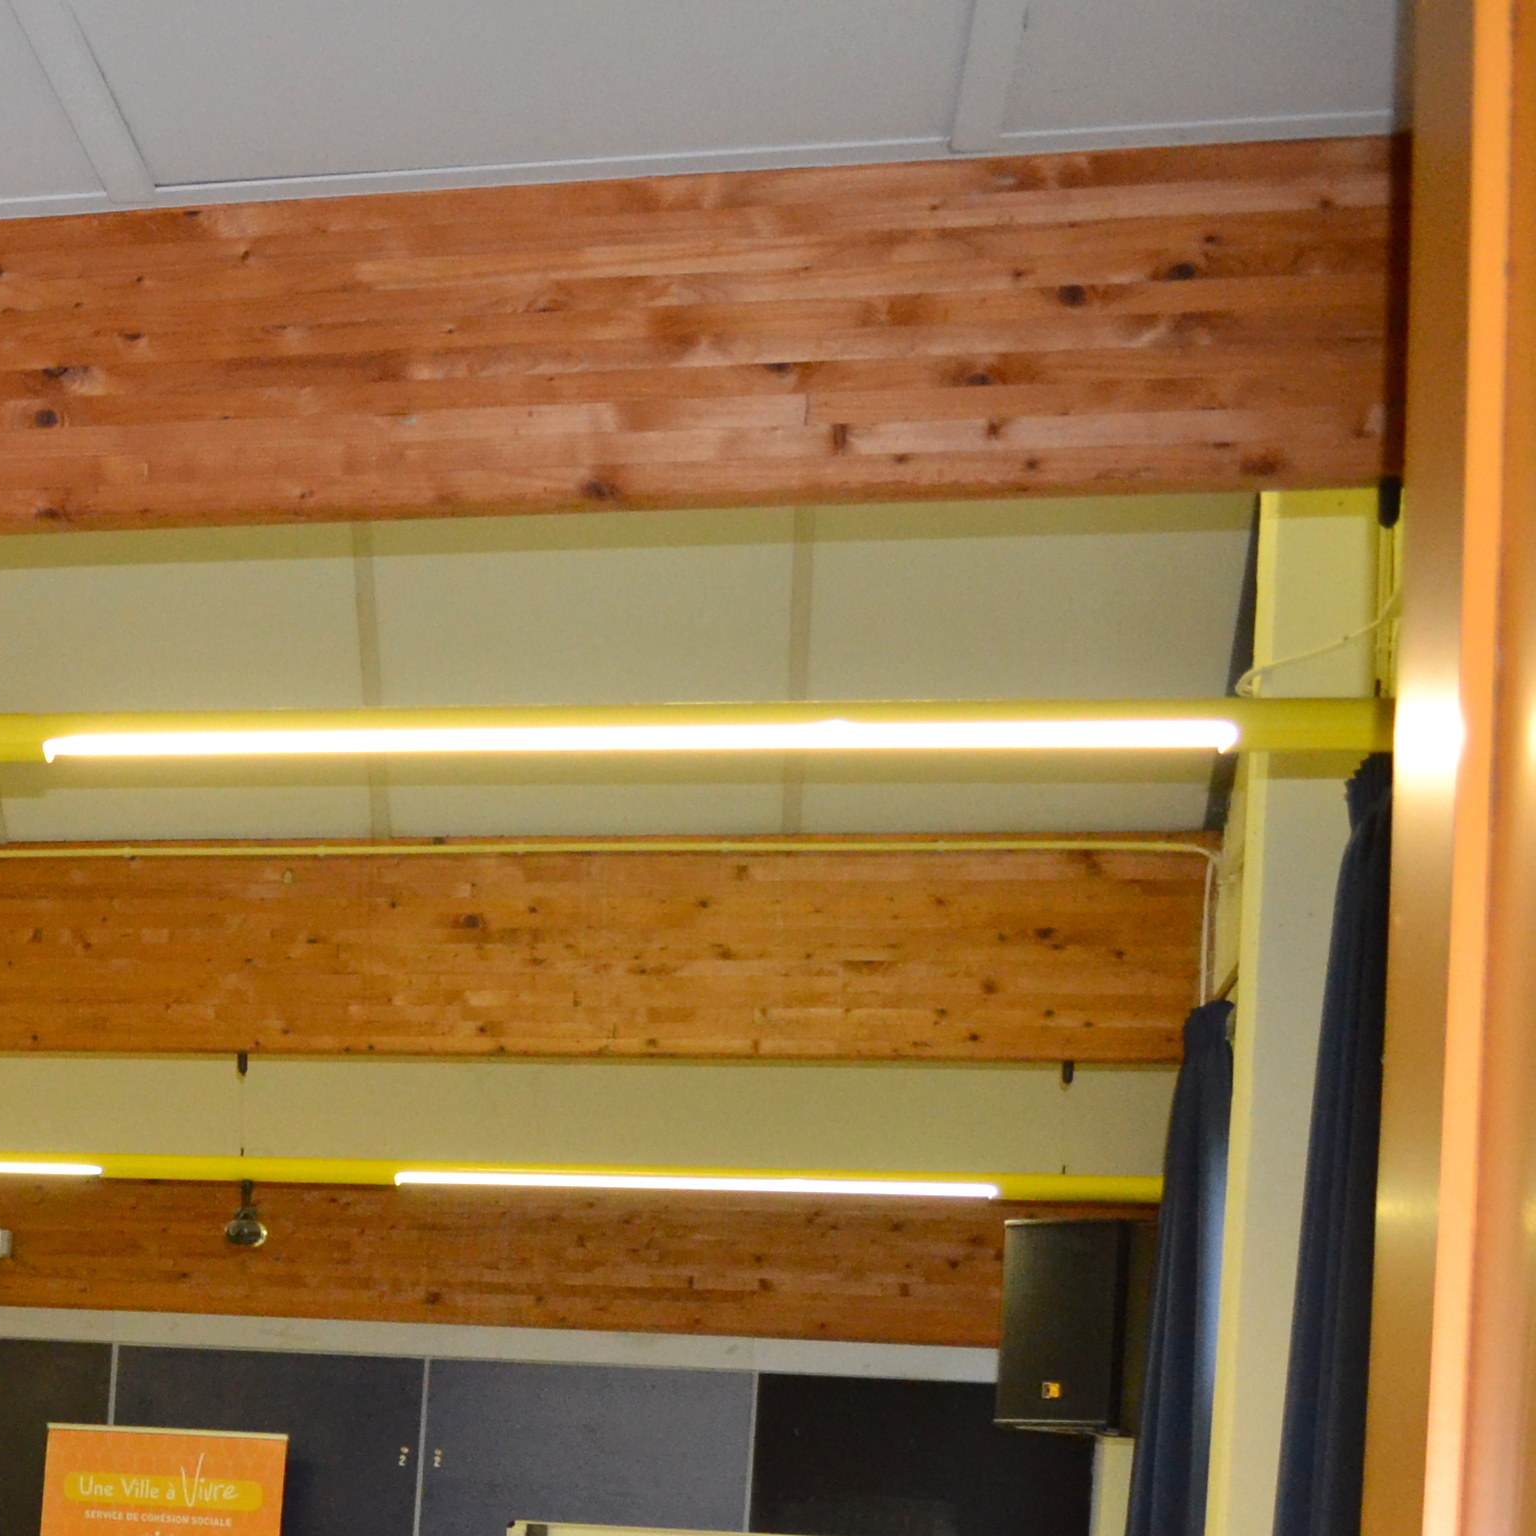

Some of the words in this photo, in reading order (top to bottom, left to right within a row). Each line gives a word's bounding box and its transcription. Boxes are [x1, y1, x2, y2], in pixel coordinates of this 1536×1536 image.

[79, 1475, 113, 1496] Une
[121, 1478, 159, 1499] Ville
[166, 1483, 176, 1500] à
[181, 1452, 239, 1507] Vivre
[85, 1509, 123, 1520] SERVICE
[126, 1511, 139, 1521] DE
[141, 1511, 189, 1524] COHÉSION
[191, 1515, 232, 1527] SOCIALE
